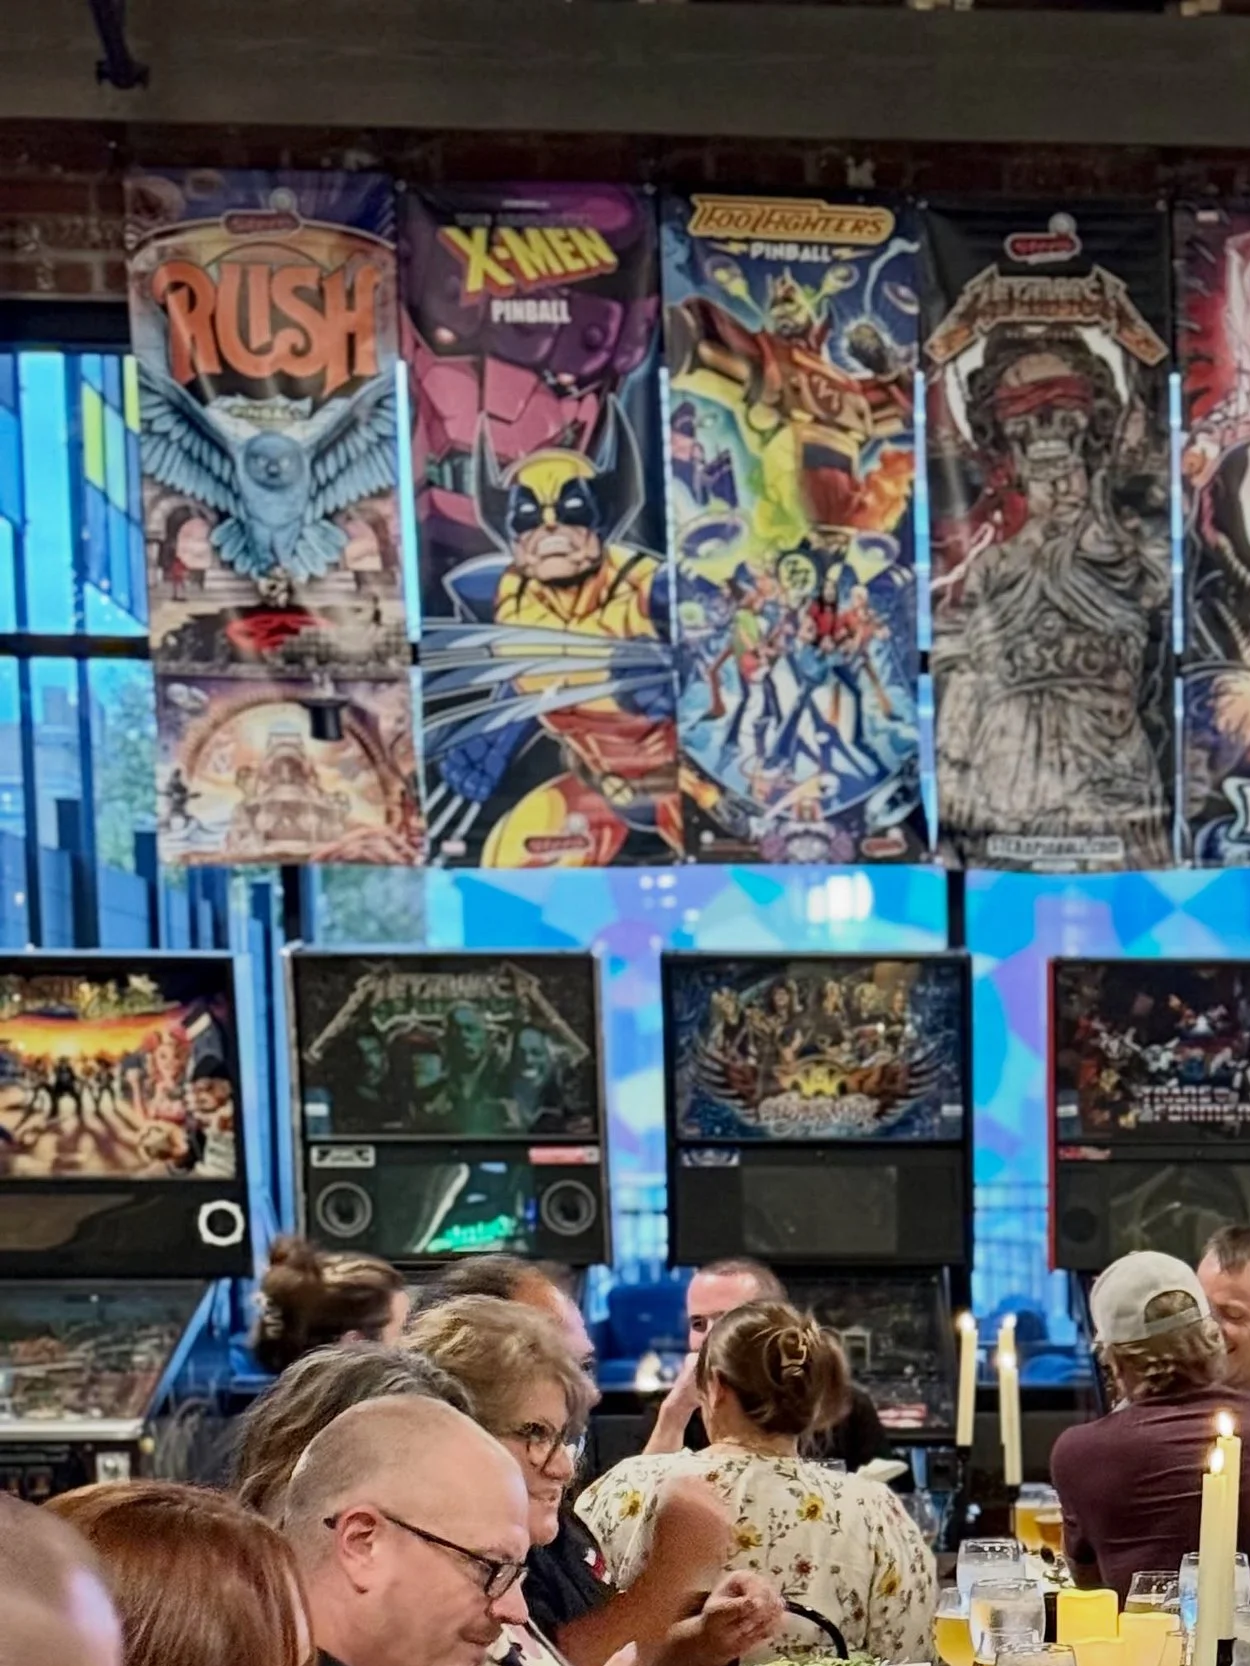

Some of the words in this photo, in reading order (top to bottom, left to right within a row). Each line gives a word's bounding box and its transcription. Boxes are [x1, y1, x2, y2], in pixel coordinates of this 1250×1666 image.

[437, 226, 620, 292] X-MEN
[750, 242, 832, 263] PINBALL
[152, 259, 382, 398] RUSH
[491, 300, 571, 323] PINBALL
